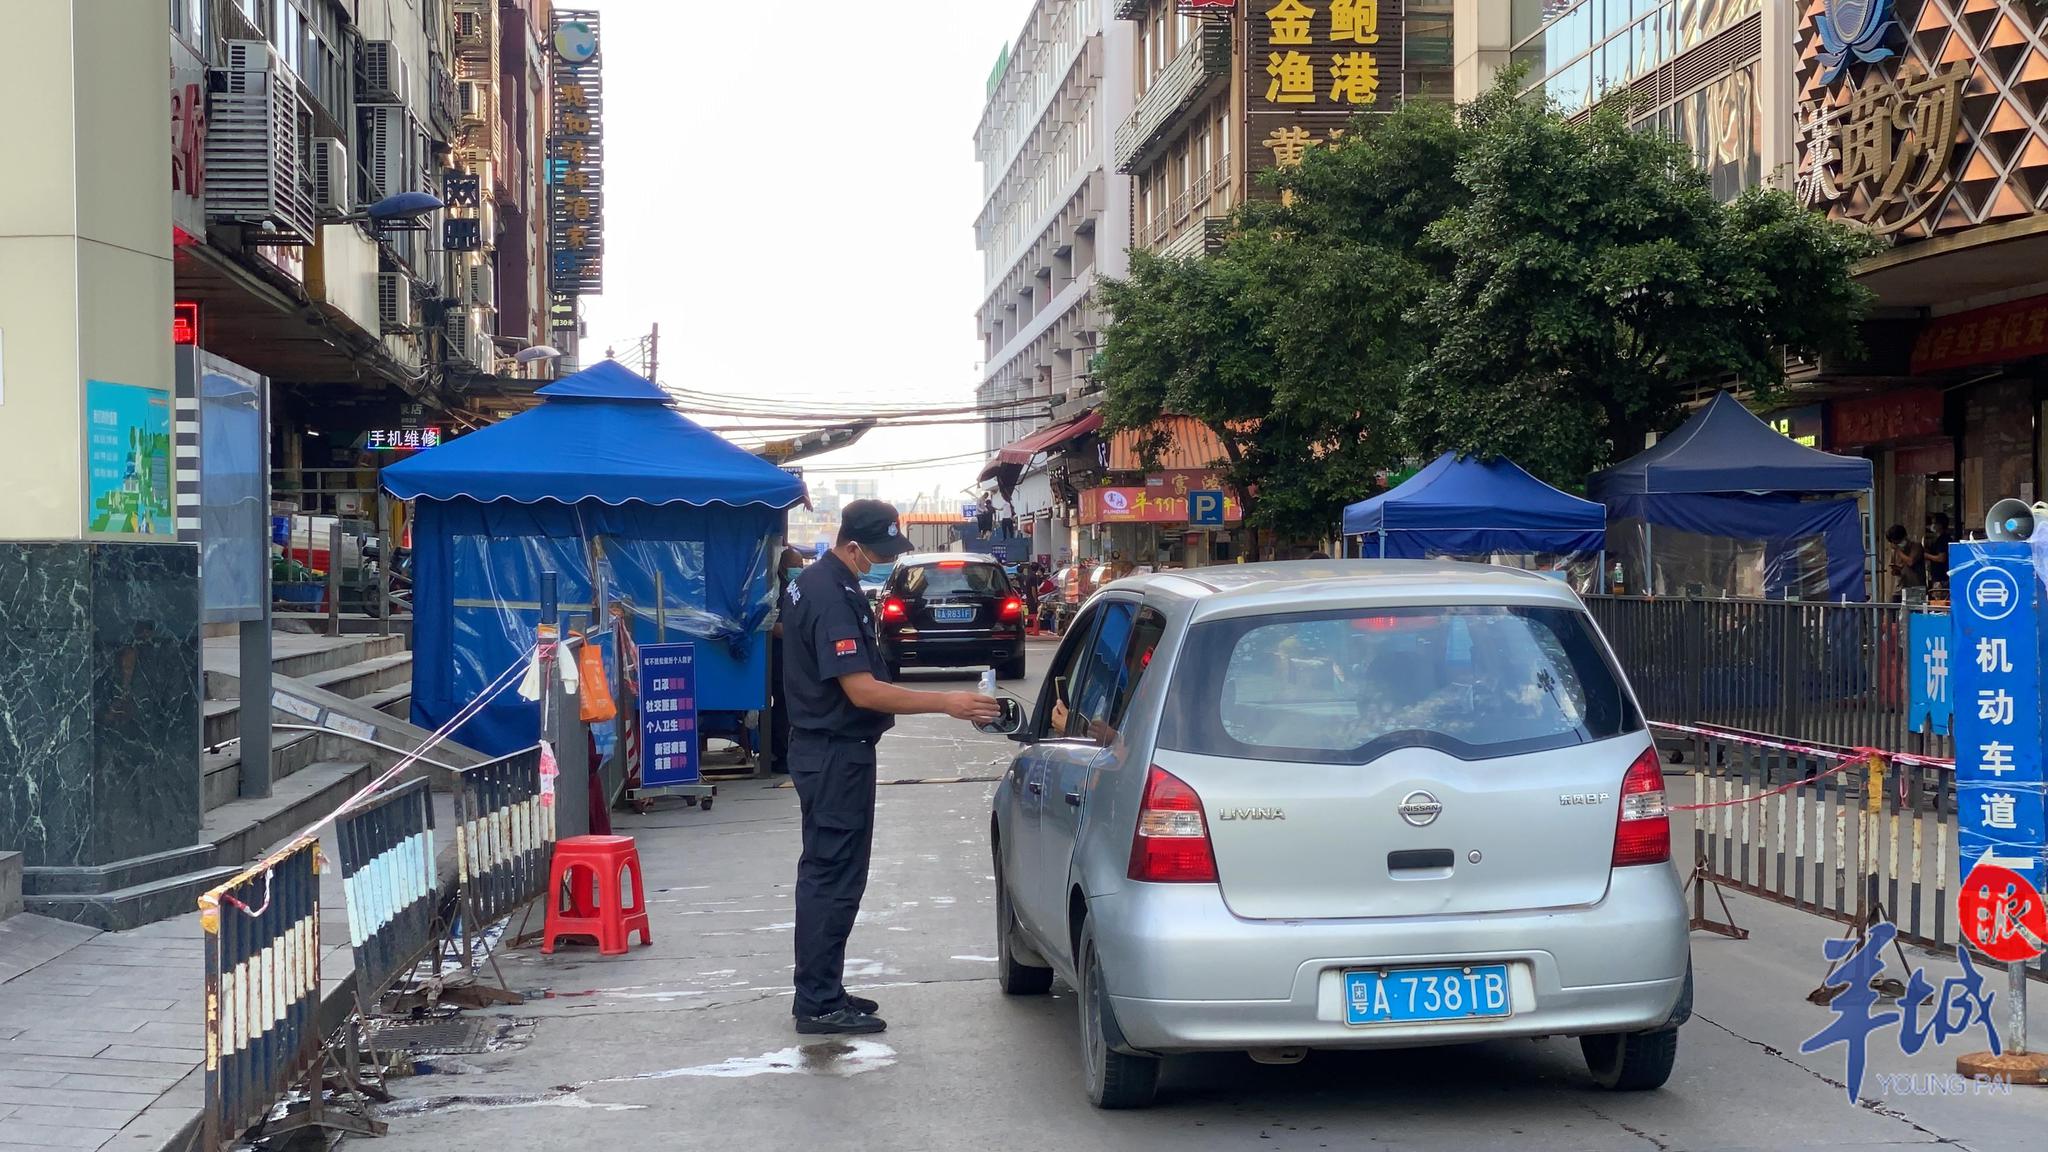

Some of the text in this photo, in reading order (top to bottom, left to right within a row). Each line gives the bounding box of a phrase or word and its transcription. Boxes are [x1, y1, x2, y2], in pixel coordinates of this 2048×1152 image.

[1797, 60, 1971, 235] 莱茵河
[370, 430, 437, 447] 手机维修
[1196, 495, 1216, 520] P
[653, 677, 685, 691] 口罩
[645, 697, 693, 713] 社交距离
[646, 718, 694, 734] 个人卫生
[1975, 636, 2018, 830] 机动车道
[655, 755, 688, 770] 疫苗种
[1560, 792, 1610, 805] 东风日产
[1219, 807, 1286, 820] LIVINA
[1403, 804, 1439, 812] NISSAN
